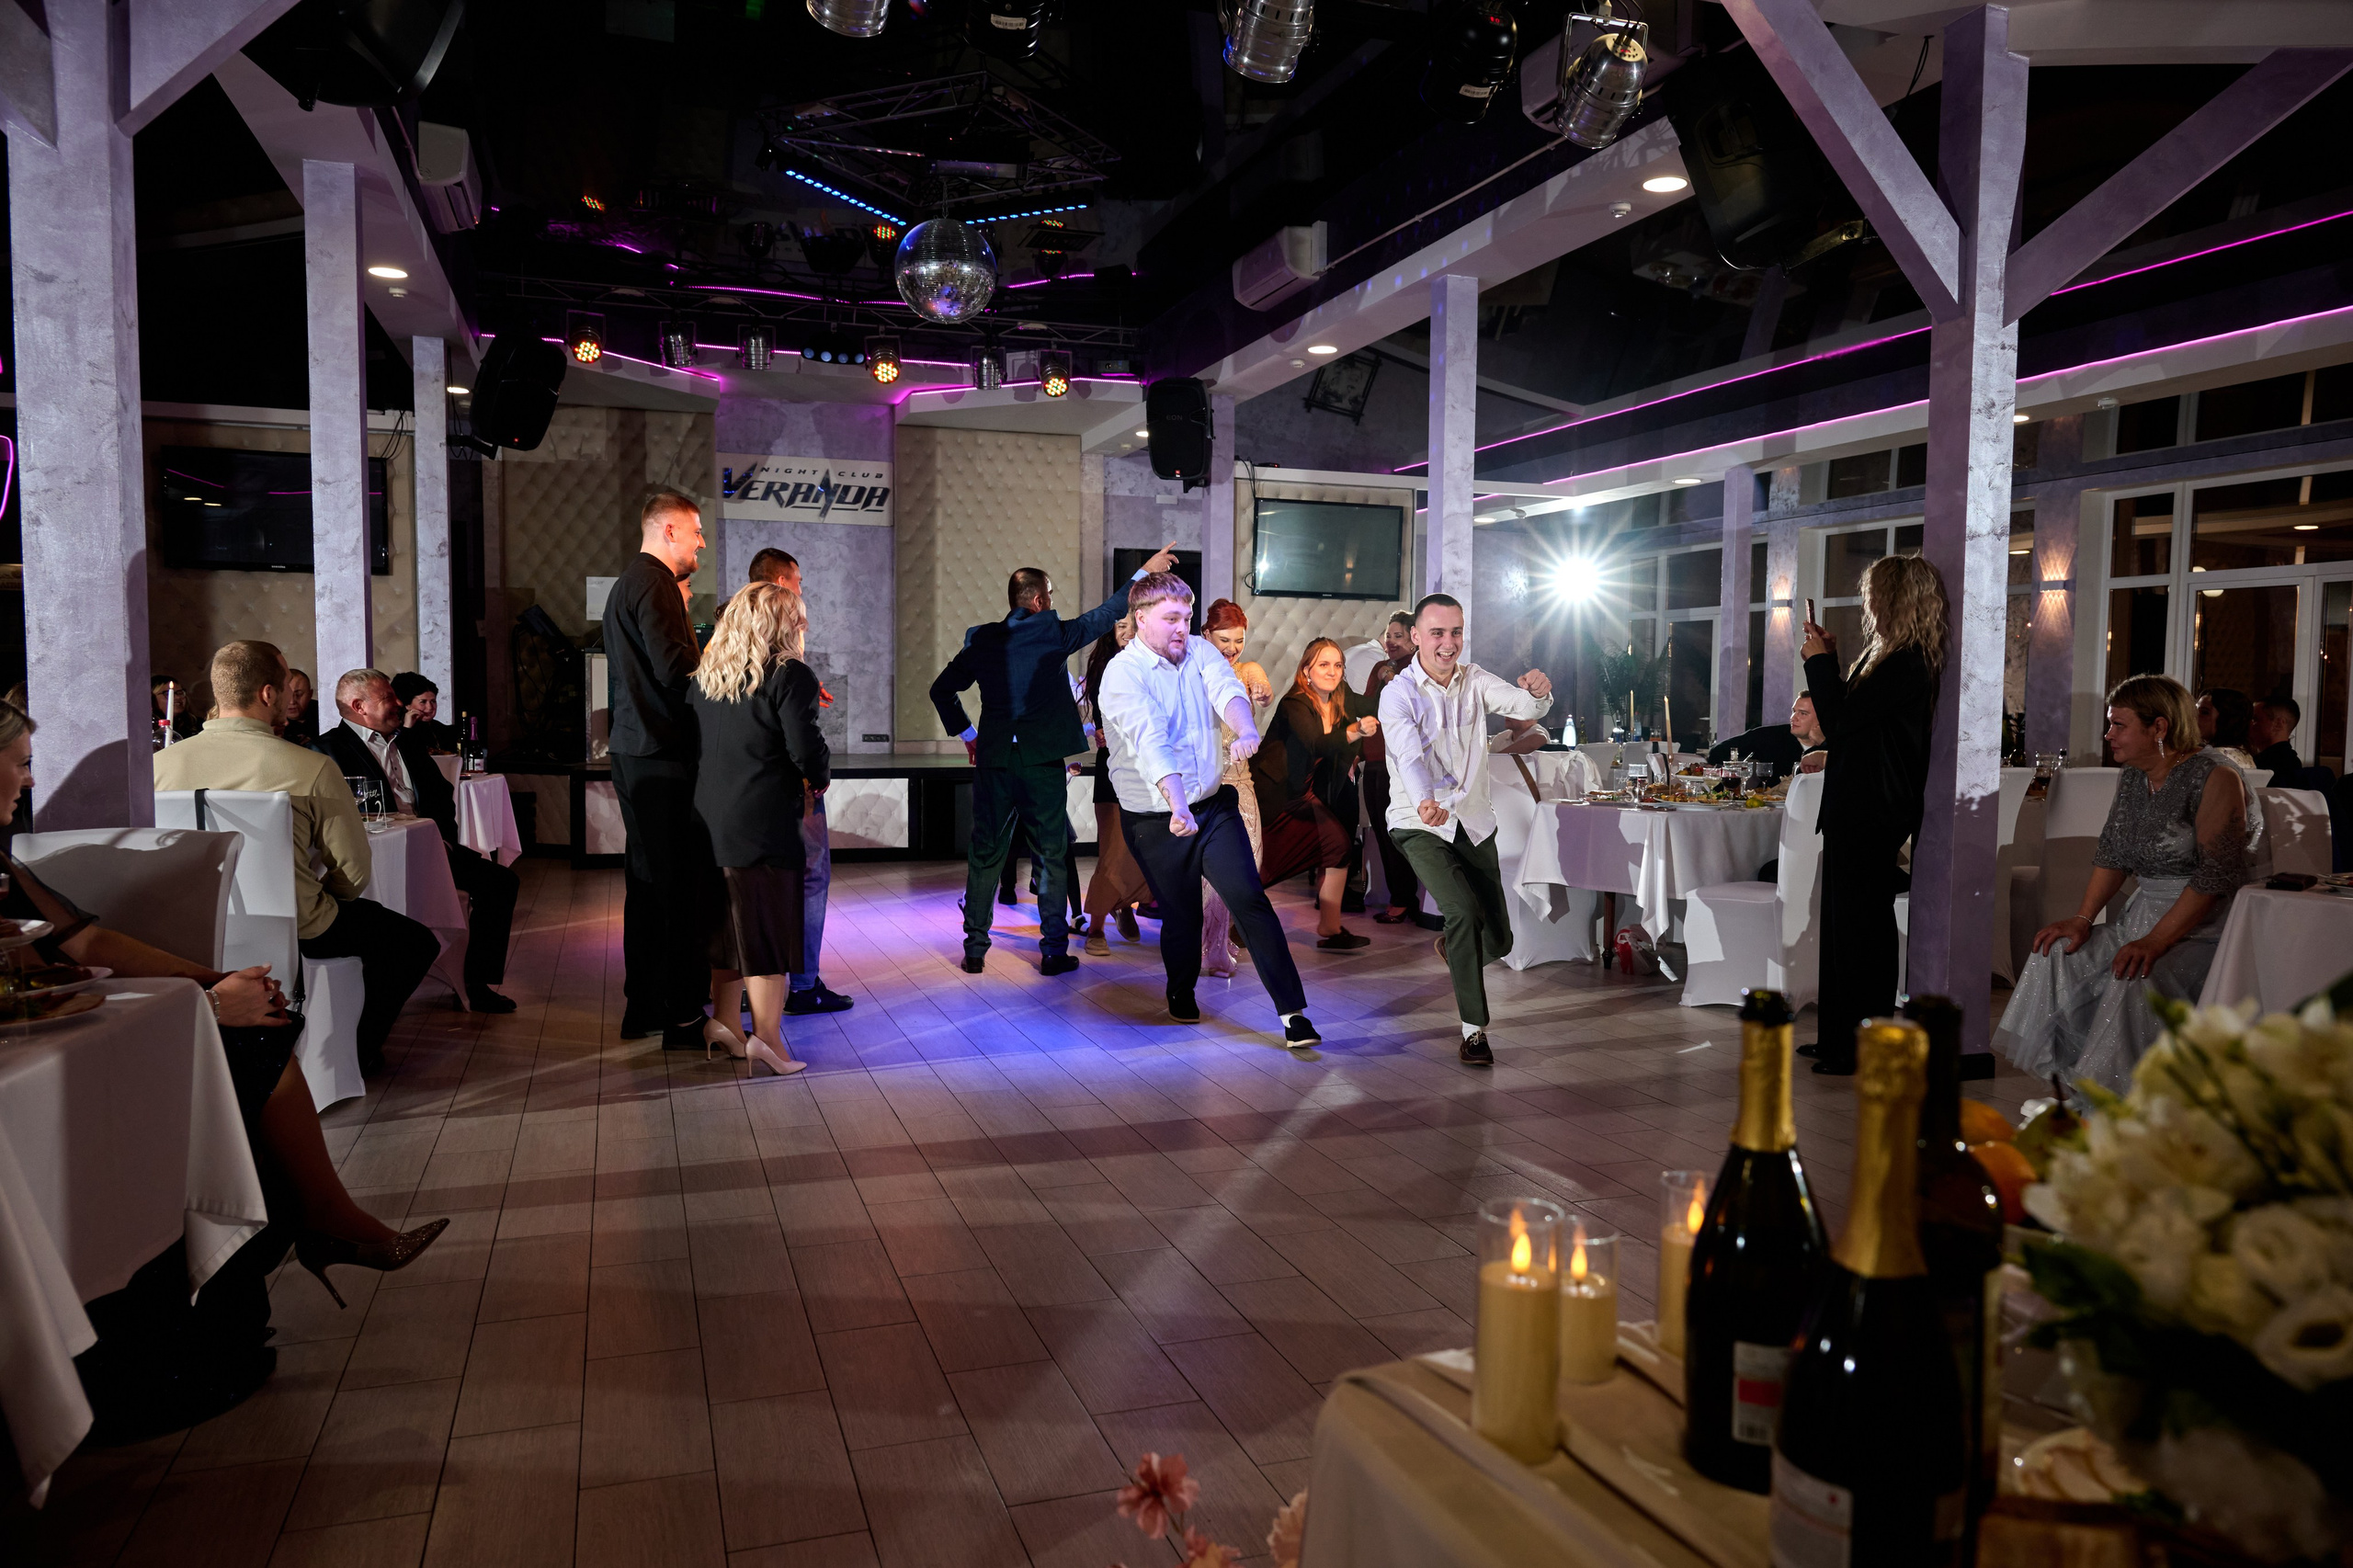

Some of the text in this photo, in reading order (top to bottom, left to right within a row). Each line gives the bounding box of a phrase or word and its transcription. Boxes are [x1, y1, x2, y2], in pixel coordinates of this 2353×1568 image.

[760, 466, 884, 479] NIGHT CLUB
[722, 462, 891, 519] VERANDA
[374, 800, 384, 823] 2
